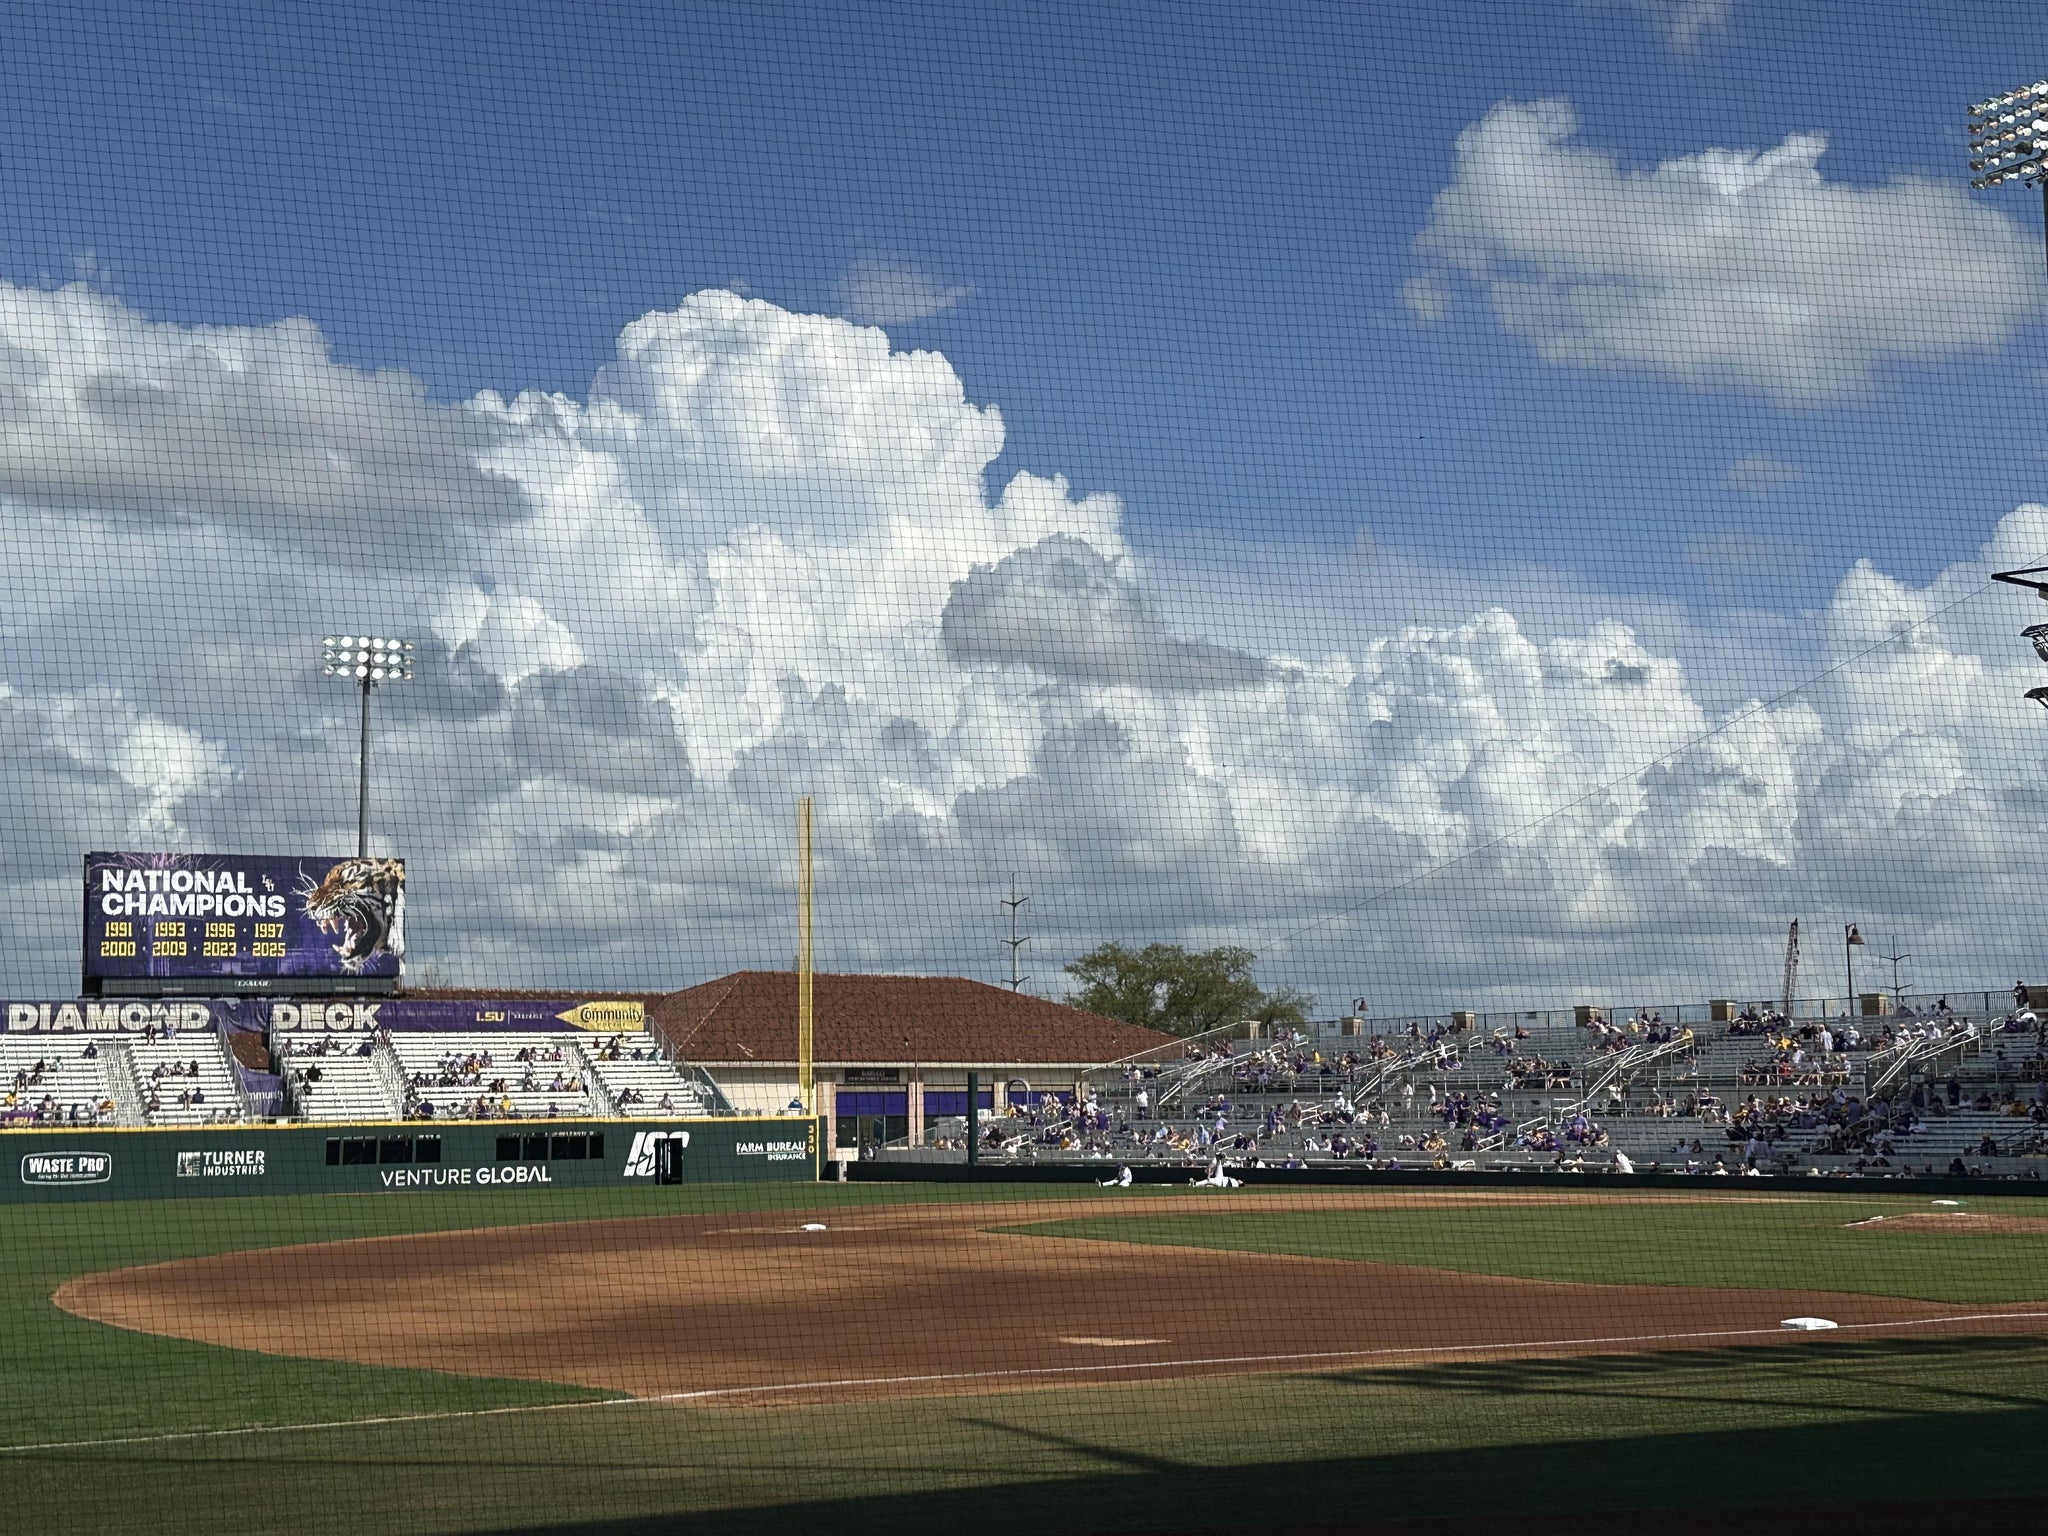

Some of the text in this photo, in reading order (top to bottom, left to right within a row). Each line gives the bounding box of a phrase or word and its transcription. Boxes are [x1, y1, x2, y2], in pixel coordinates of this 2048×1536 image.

[102, 869, 253, 893] NATIONAL
[101, 892, 286, 917] CHAMPIONS
[105, 922, 285, 938] 1991 1993 1996 1997
[101, 941, 287, 957] 2000 2009 2023 2025
[8, 1003, 381, 1031] DIAMOND DECK
[476, 1011, 505, 1021] LSU
[580, 1007, 643, 1022] Community
[736, 1141, 806, 1153] FARM BUREAU
[29, 1156, 104, 1173] WASTE PRO
[203, 1150, 265, 1165] TURNER
[203, 1165, 265, 1176] INDUSTRIES
[381, 1165, 552, 1187] VENTURE GLOBAL
